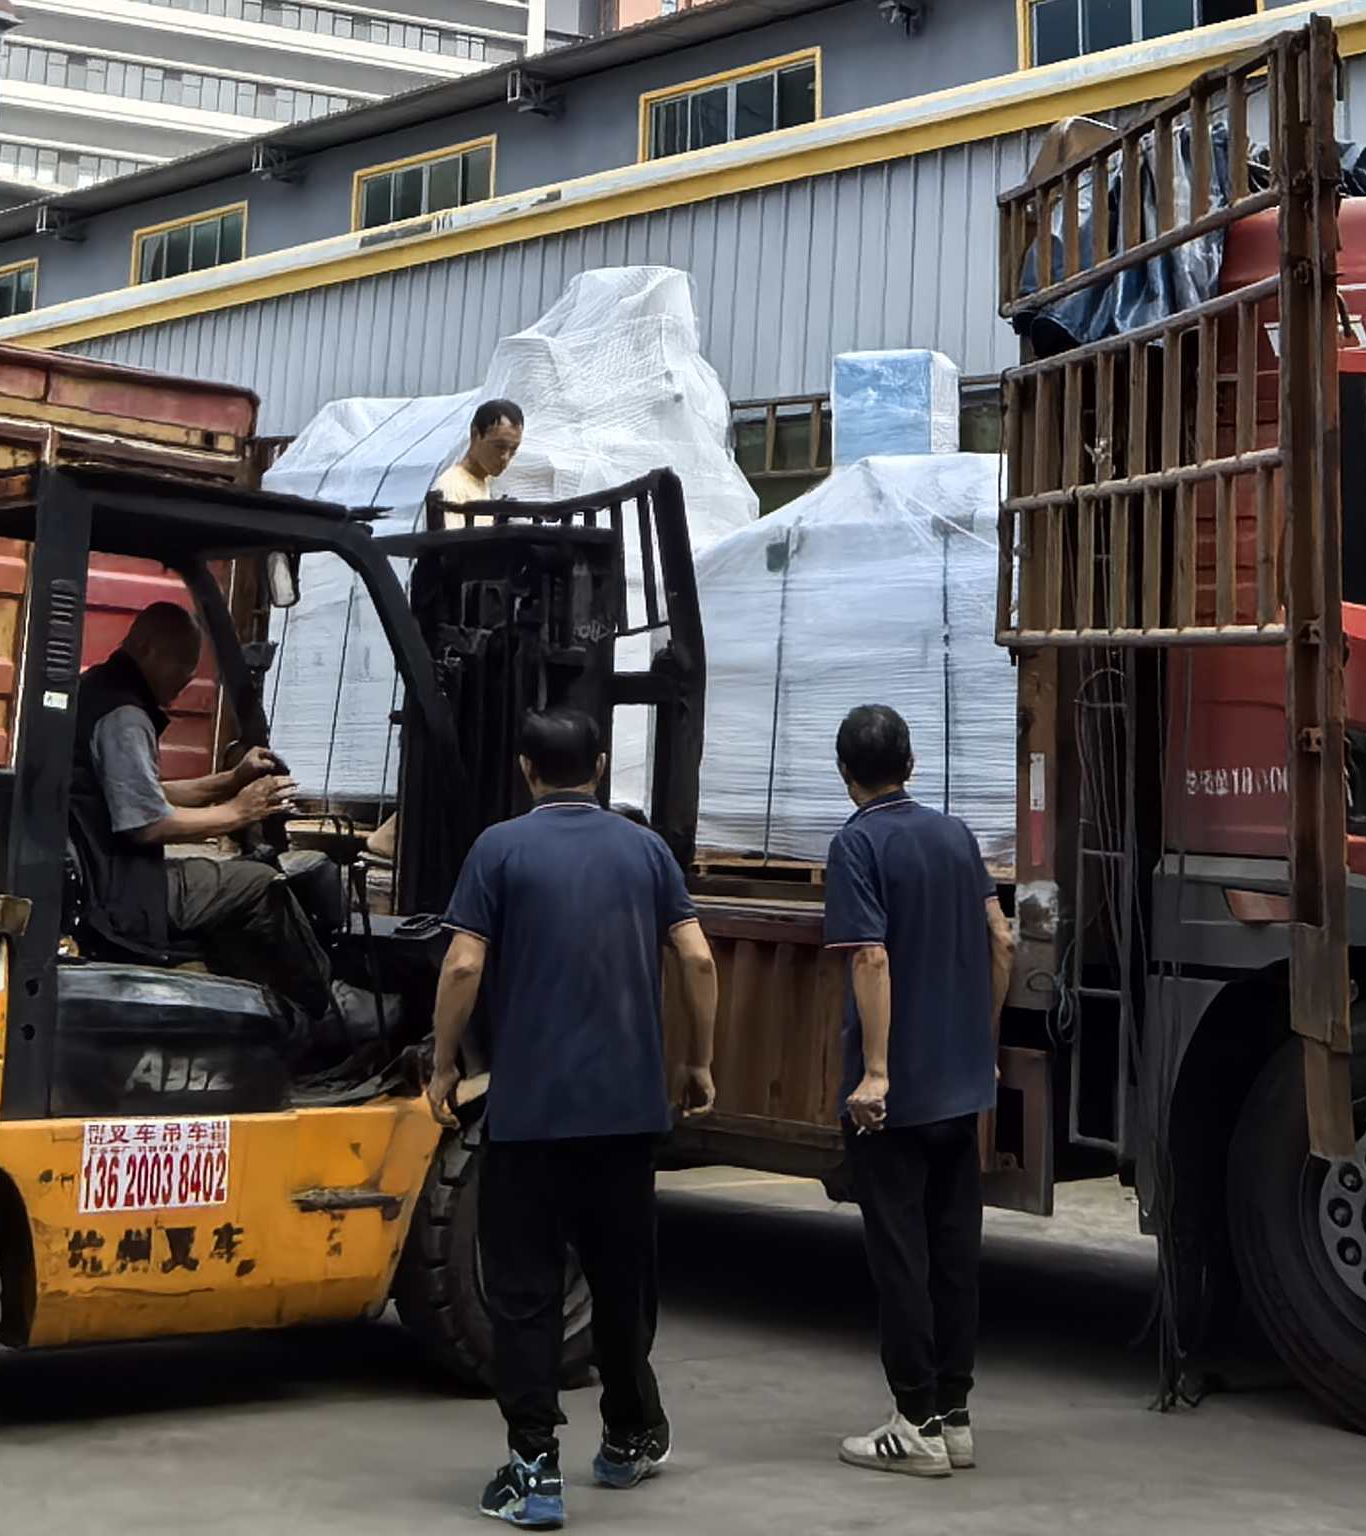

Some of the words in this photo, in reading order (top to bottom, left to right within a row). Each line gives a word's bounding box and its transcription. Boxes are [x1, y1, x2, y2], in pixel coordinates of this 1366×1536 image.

[83, 1153, 120, 1209] 136
[123, 1152, 174, 1207] 2003
[178, 1149, 227, 1203] 8402
